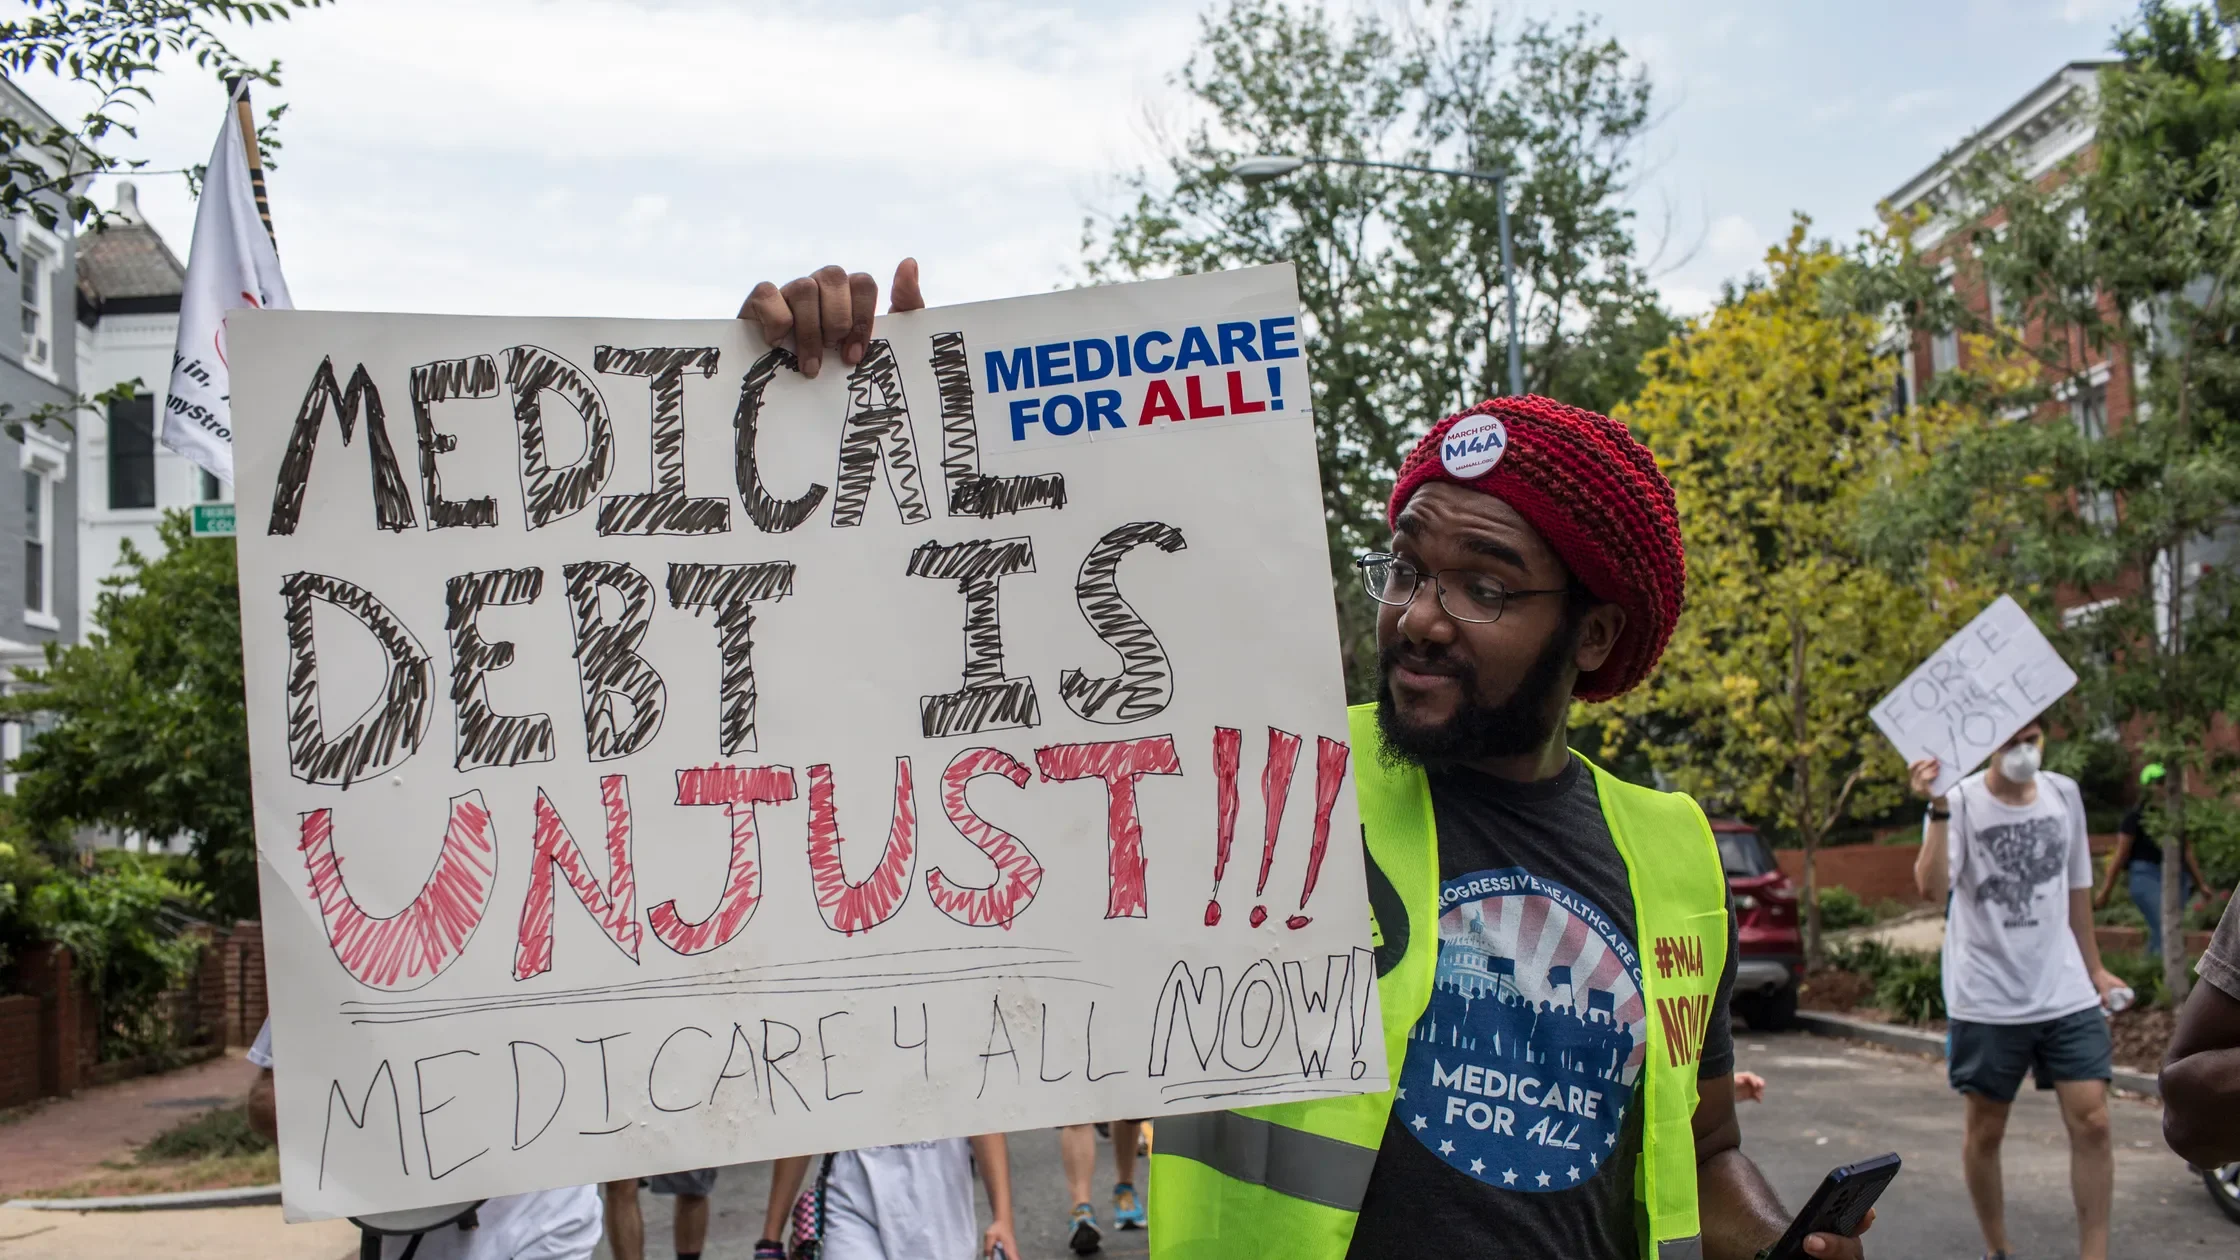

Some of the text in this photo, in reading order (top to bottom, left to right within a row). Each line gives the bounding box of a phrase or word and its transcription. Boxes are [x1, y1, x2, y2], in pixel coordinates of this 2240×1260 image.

[183, 360, 210, 388] in,
[984, 316, 1299, 393] MEDICARE
[166, 394, 232, 442] nyStro
[267, 331, 1067, 537] MEDICAL
[1008, 366, 1285, 442] FOR ALL!
[1447, 423, 1497, 441] MARCH FOR
[1445, 432, 1503, 461] M4A
[280, 522, 1187, 791] DEBT IS
[1882, 621, 2011, 736] FORCE
[1921, 663, 2047, 772] VOTE
[299, 726, 1350, 990] UNJUST!!!
[1541, 883, 1636, 966] HEALTHCARE
[1654, 935, 1704, 979] #M4A
[318, 1008, 863, 1190] MEDICARE
[893, 1003, 929, 1081] 4
[976, 994, 1128, 1099] ALL
[1148, 946, 1376, 1081] NOW!
[1656, 994, 1709, 1068] NOW!
[1432, 1058, 1602, 1120] MEDICARE
[1444, 1096, 1581, 1150] FOR ALL
